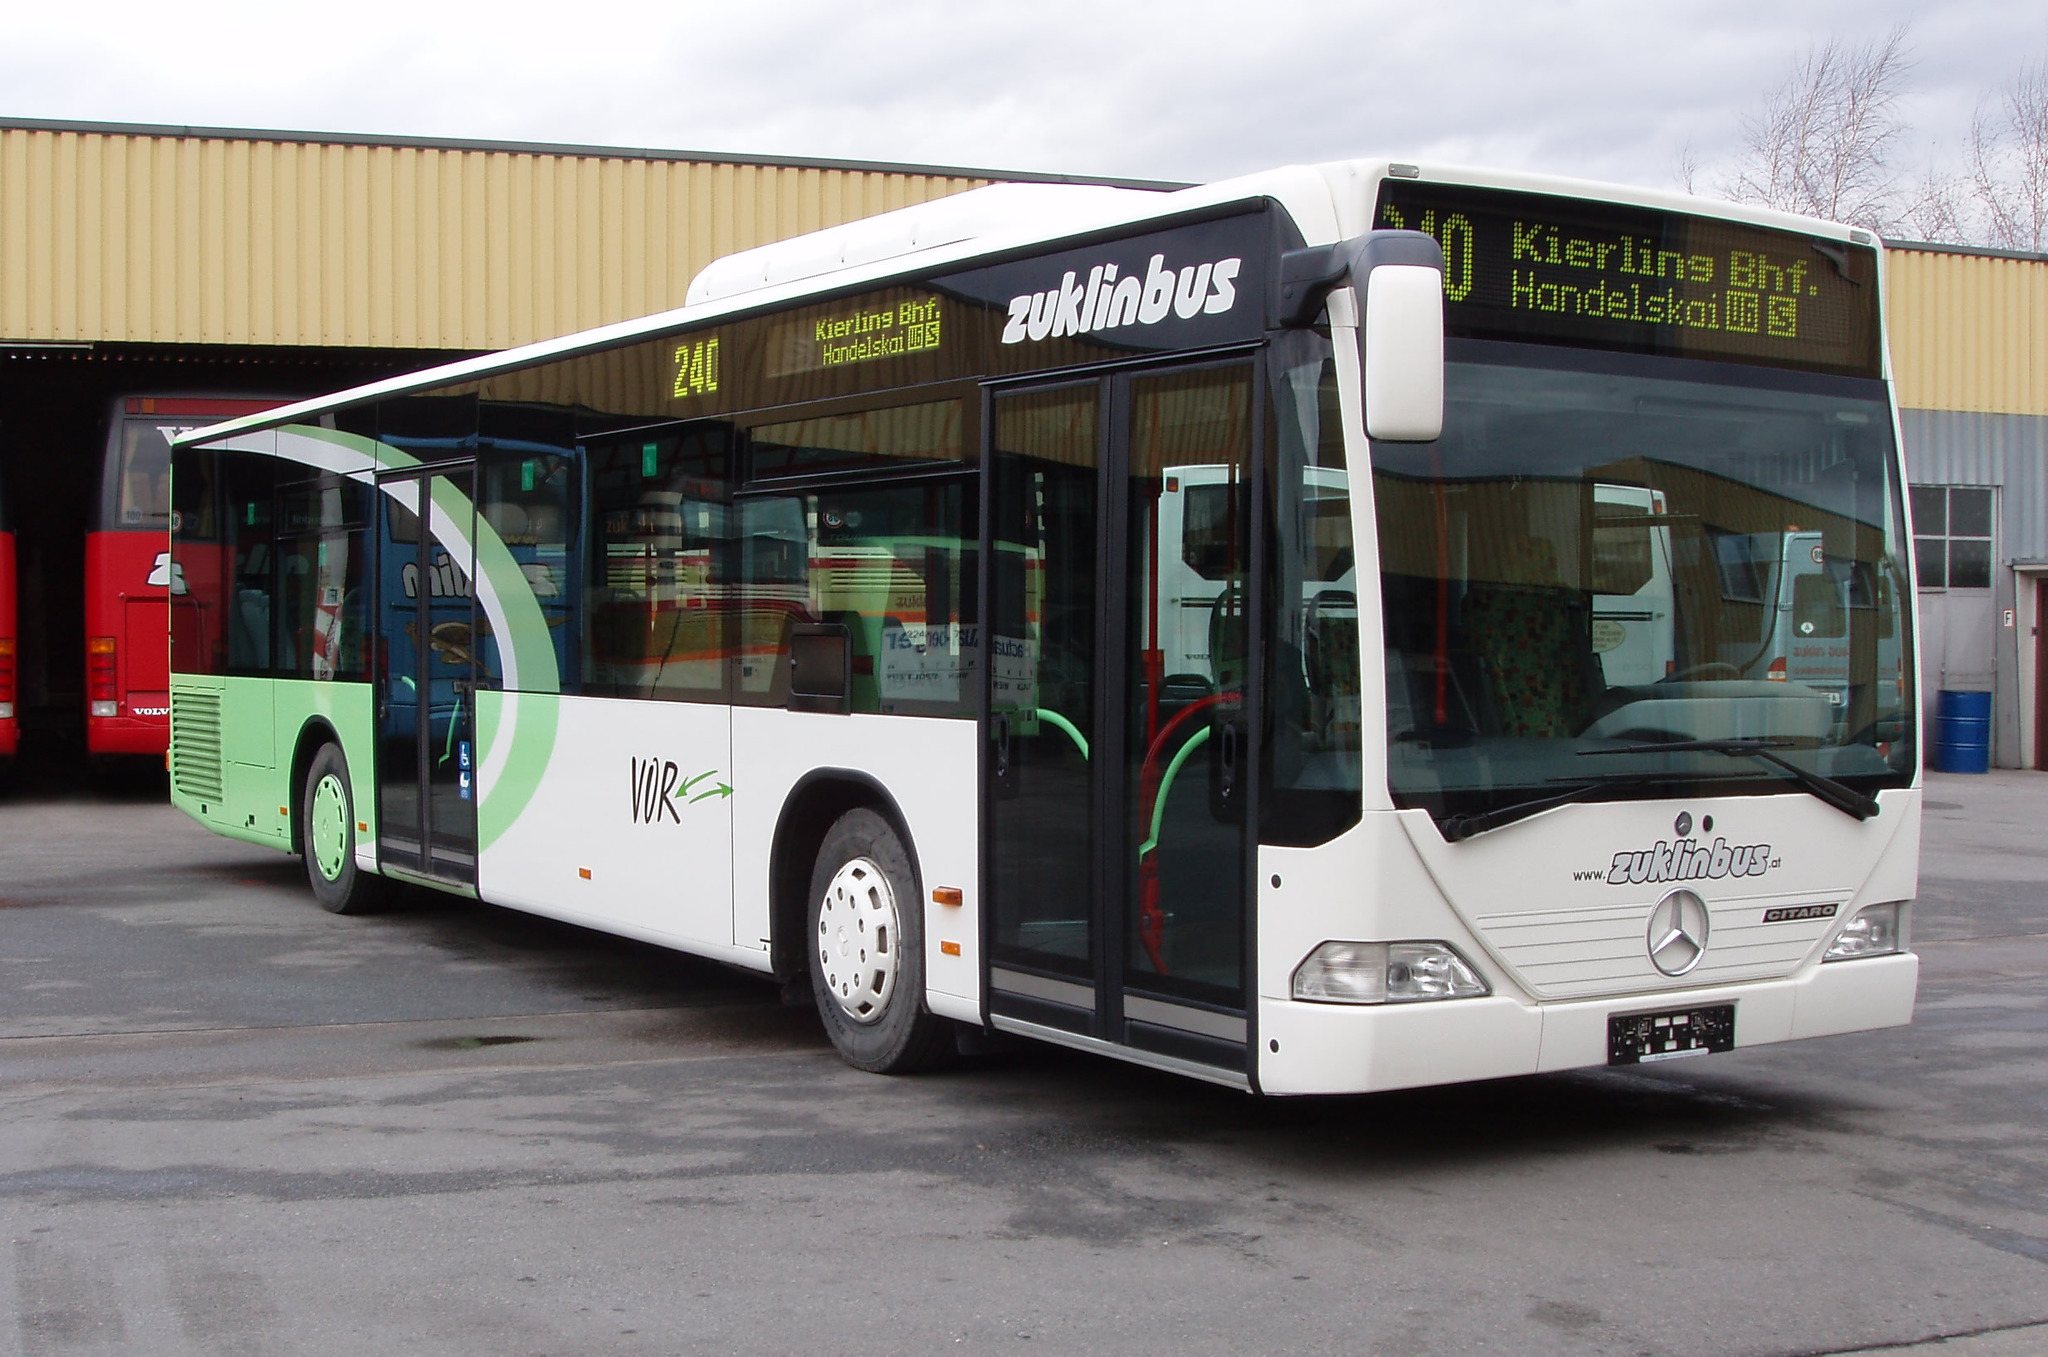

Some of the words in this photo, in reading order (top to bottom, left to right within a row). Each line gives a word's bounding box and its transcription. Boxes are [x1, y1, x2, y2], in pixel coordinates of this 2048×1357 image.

[1512, 220, 1714, 284] Kierling
[1730, 249, 1818, 296] Bhf.
[815, 309, 894, 342] Kierling
[899, 296, 941, 326] Bhf.
[1001, 253, 1242, 345] zuklinbus
[1512, 268, 1719, 331] Handelskai
[673, 338, 720, 398] 240
[823, 330, 905, 366] Handelskai
[132, 707, 170, 716] VOLV
[631, 755, 681, 825] VOR
[1766, 905, 1836, 922] CITARO
